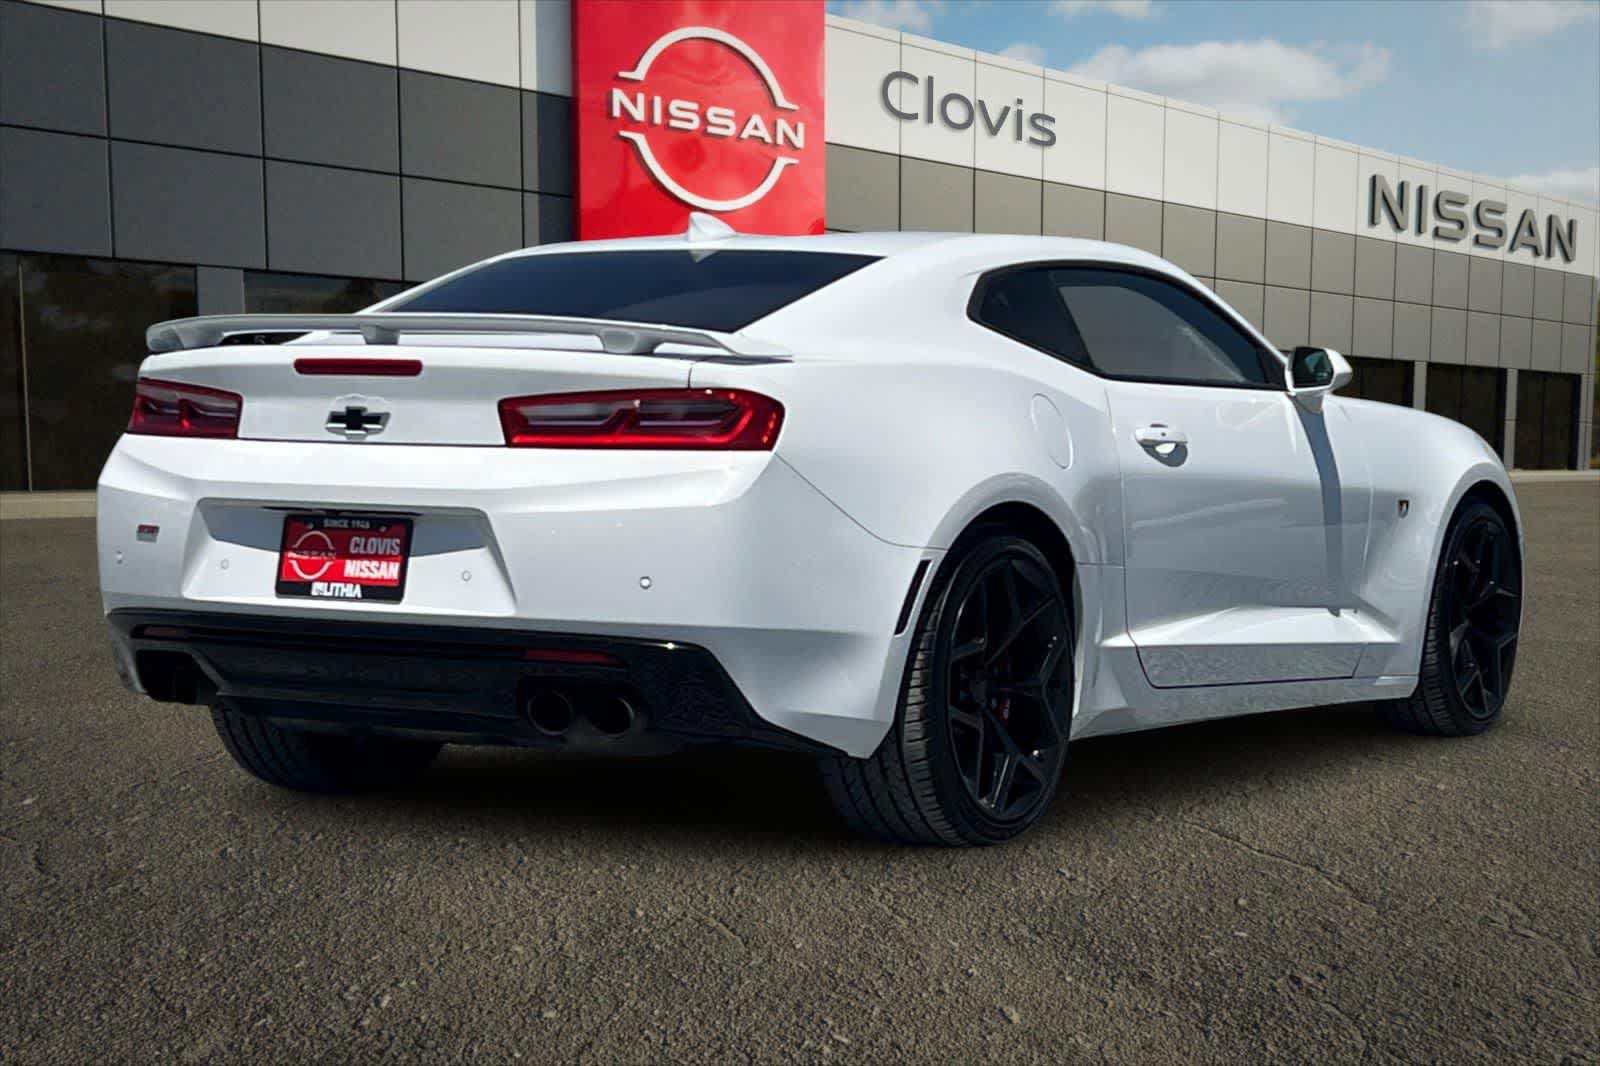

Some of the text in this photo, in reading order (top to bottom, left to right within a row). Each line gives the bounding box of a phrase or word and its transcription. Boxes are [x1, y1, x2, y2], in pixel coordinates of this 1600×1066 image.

[611, 88, 805, 149] NISSAN
[881, 70, 1057, 147] Clovis
[1368, 173, 1578, 264] NISSAN
[343, 559, 401, 580] NISSAN
[349, 536, 401, 555] CLOVIS
